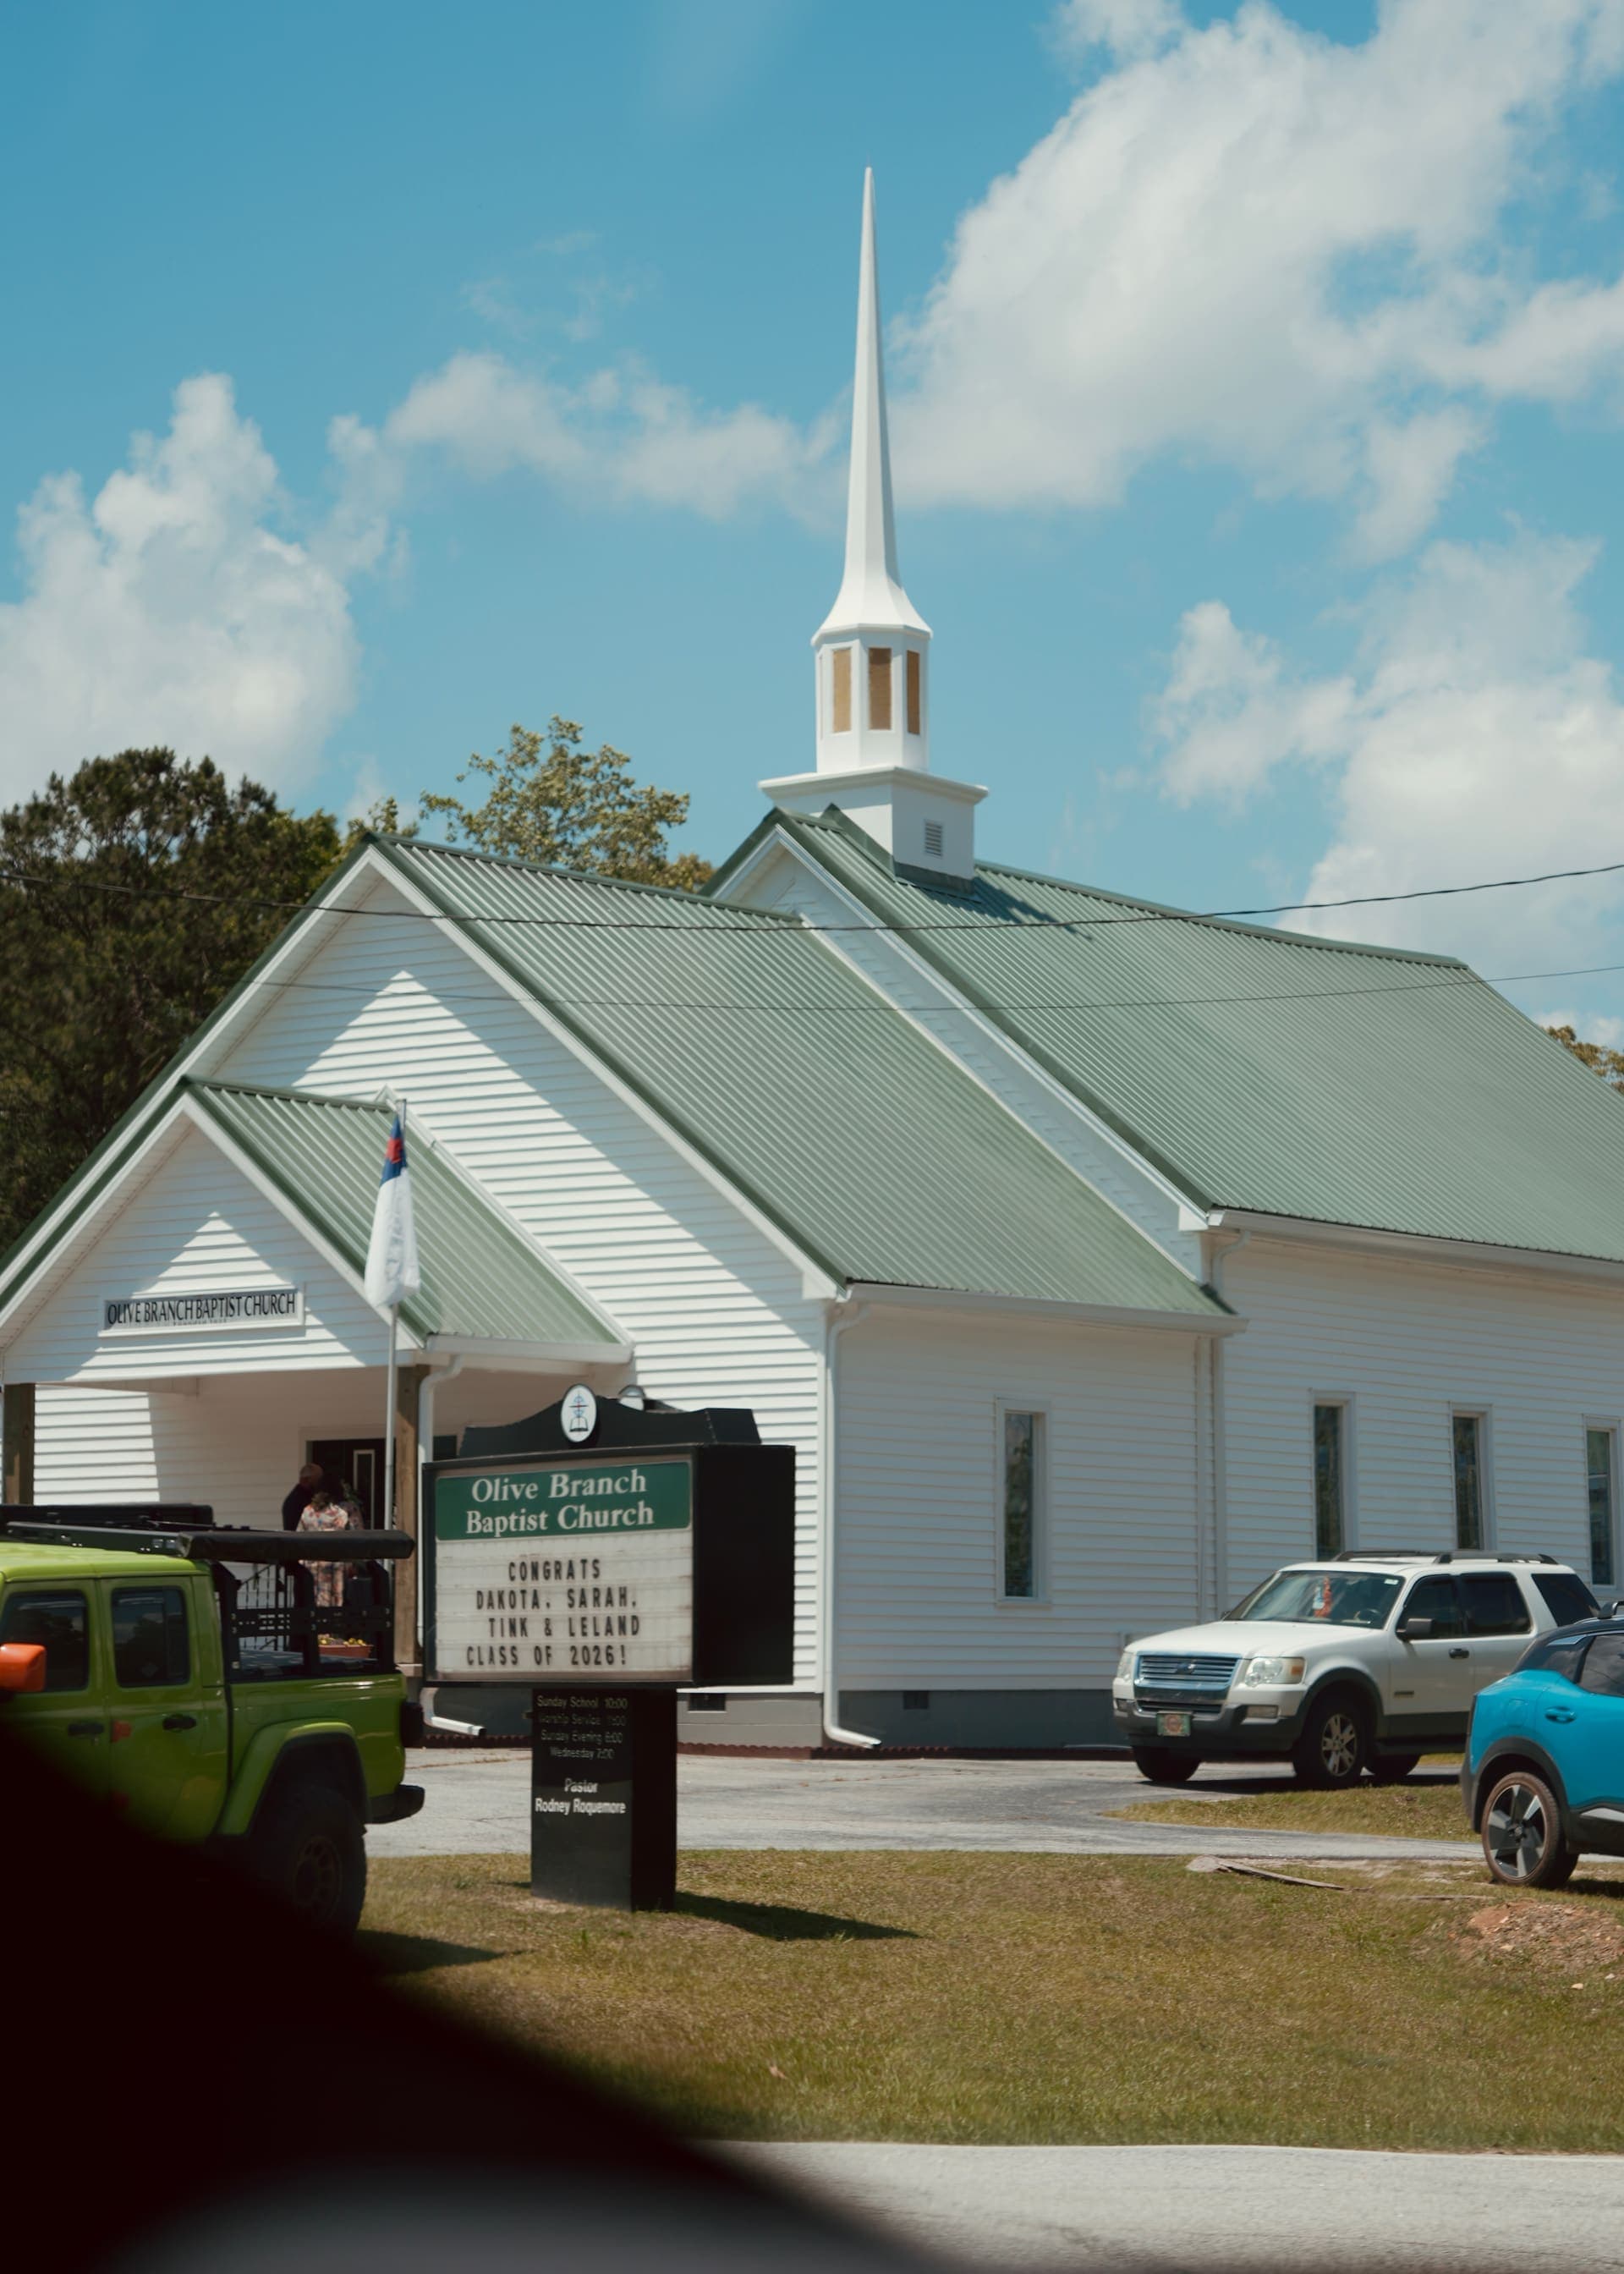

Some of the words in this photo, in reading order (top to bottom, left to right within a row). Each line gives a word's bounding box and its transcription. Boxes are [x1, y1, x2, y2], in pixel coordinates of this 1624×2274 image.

[107, 1302, 141, 1325] OLIVE
[144, 1299, 194, 1322] BRANCH
[196, 1296, 243, 1320] BAPTIST
[244, 1293, 296, 1316] CHURCH
[471, 1478, 539, 1502] Olive
[548, 1469, 648, 1498] Branch
[466, 1508, 549, 1537] Baptist
[557, 1501, 654, 1530] Church
[508, 1559, 601, 1581] CONGRATS
[488, 1617, 528, 1638] TINK
[544, 1618, 552, 1637] &
[568, 1615, 639, 1637] LELAND
[467, 1645, 518, 1666] CLASS
[534, 1645, 552, 1666] OF
[571, 1645, 626, 1666] 2026!
[536, 1695, 568, 1709] Sunday
[569, 1695, 600, 1708] School
[550, 1746, 595, 1760] Wednesday
[564, 1777, 598, 1793] Pastor
[535, 1797, 571, 1815] Rodney
[573, 1798, 627, 1815] Roquemore
